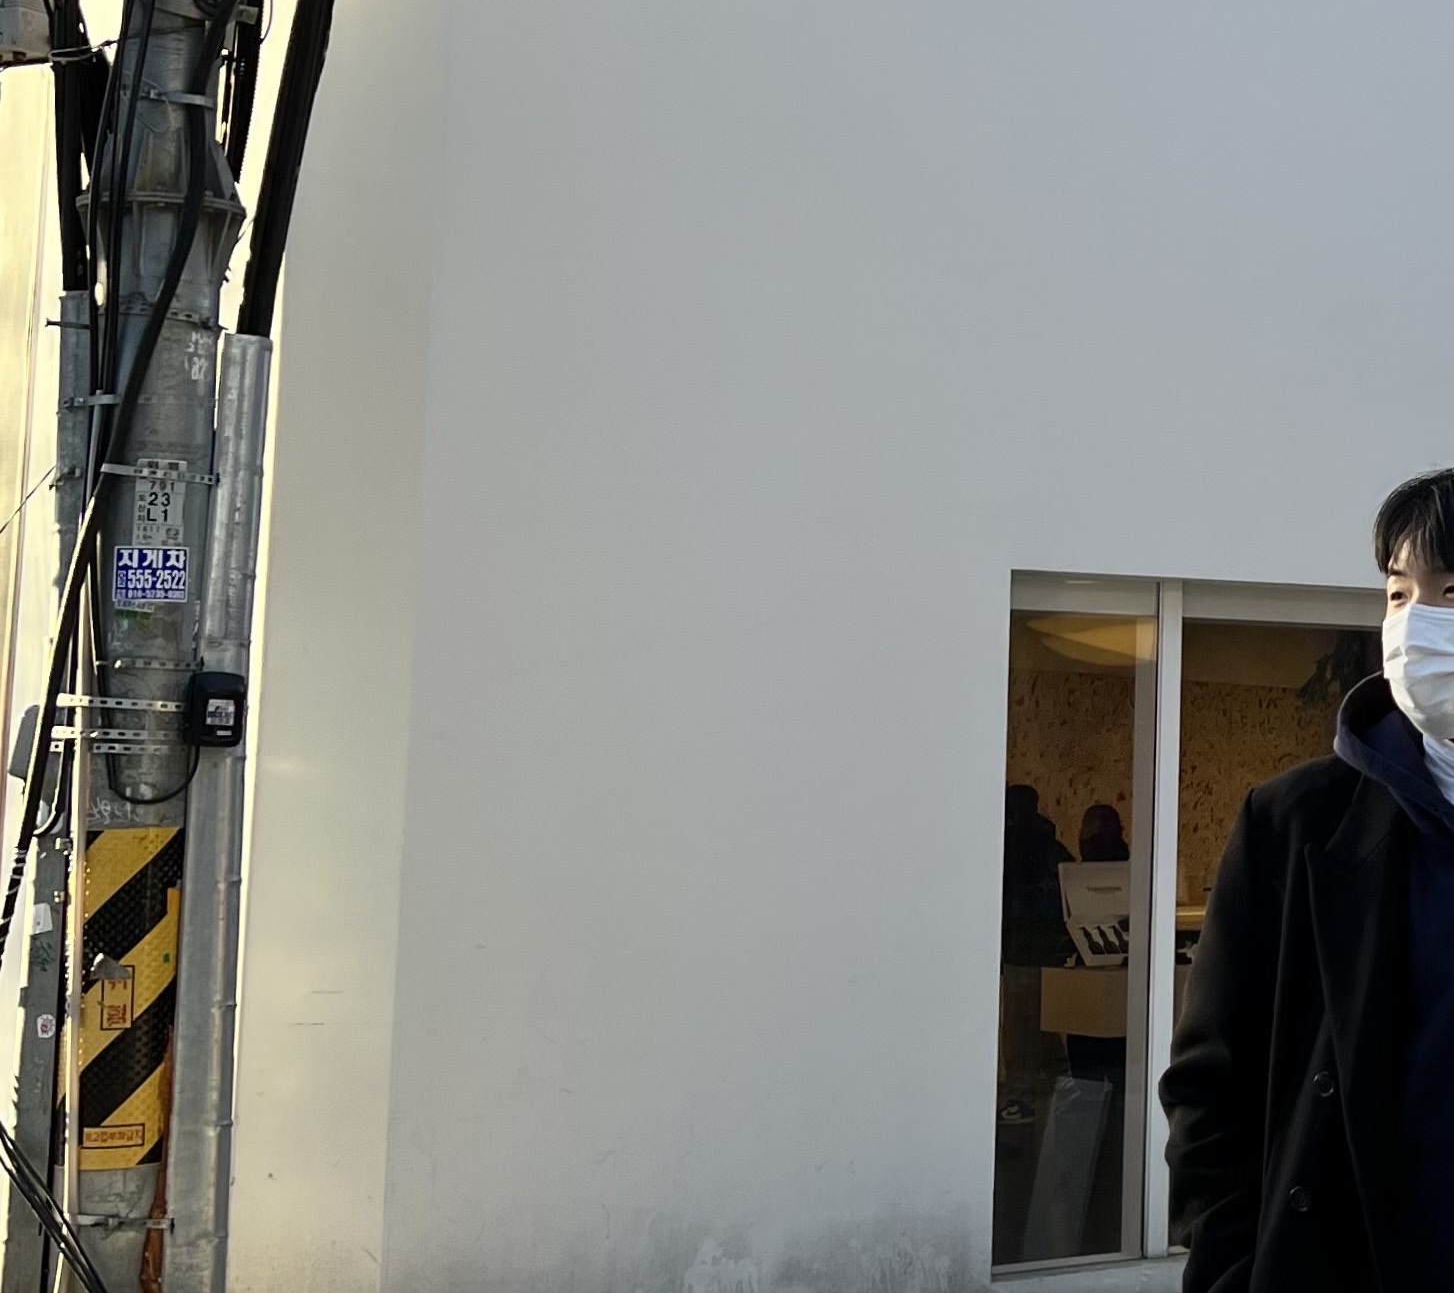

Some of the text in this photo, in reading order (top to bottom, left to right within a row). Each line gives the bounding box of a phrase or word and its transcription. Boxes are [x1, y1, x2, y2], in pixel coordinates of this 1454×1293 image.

[147, 491, 171, 507] 23
[146, 507, 169, 523] L1
[127, 569, 186, 589] 555-2522
